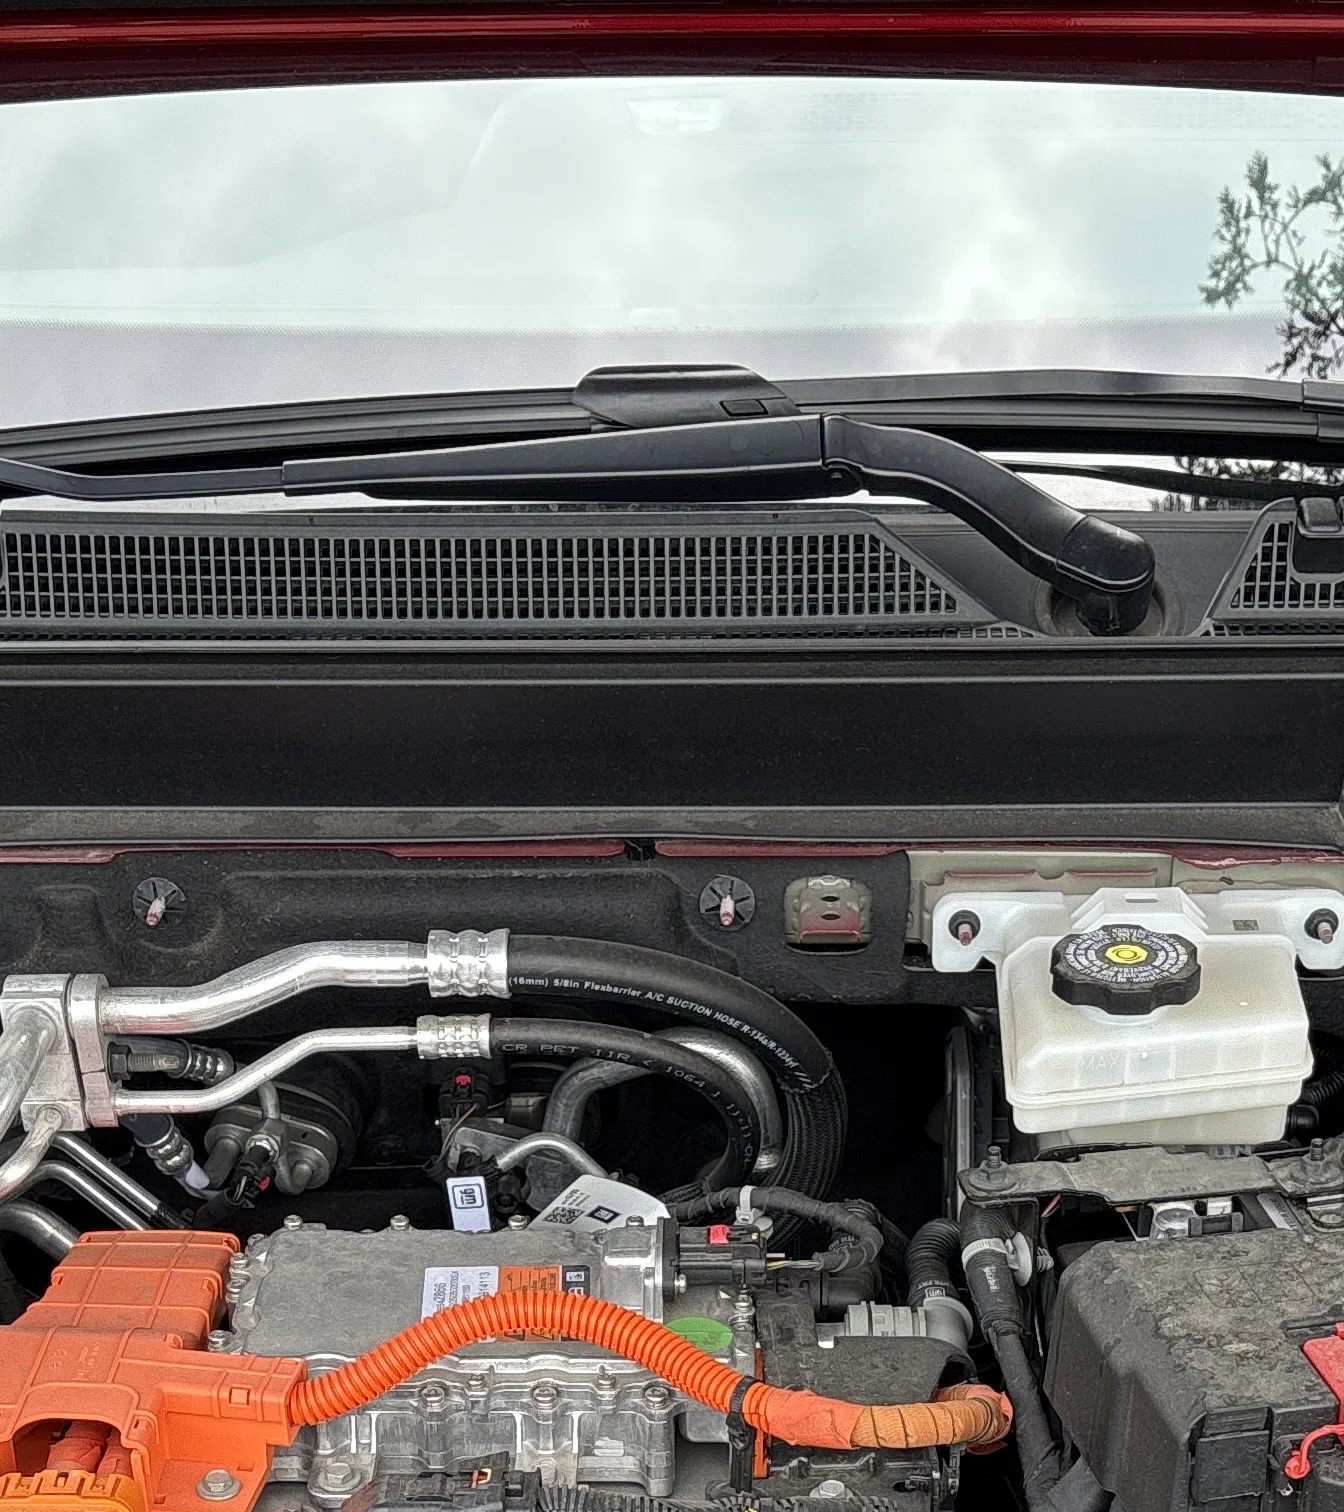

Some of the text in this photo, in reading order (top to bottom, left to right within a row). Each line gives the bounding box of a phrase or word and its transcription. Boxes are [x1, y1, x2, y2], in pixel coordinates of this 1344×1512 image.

[584, 981, 642, 997] Flexbarrier
[644, 991, 665, 1002] A/C
[666, 996, 713, 1017] SUCTION
[713, 1011, 741, 1028] HOSE
